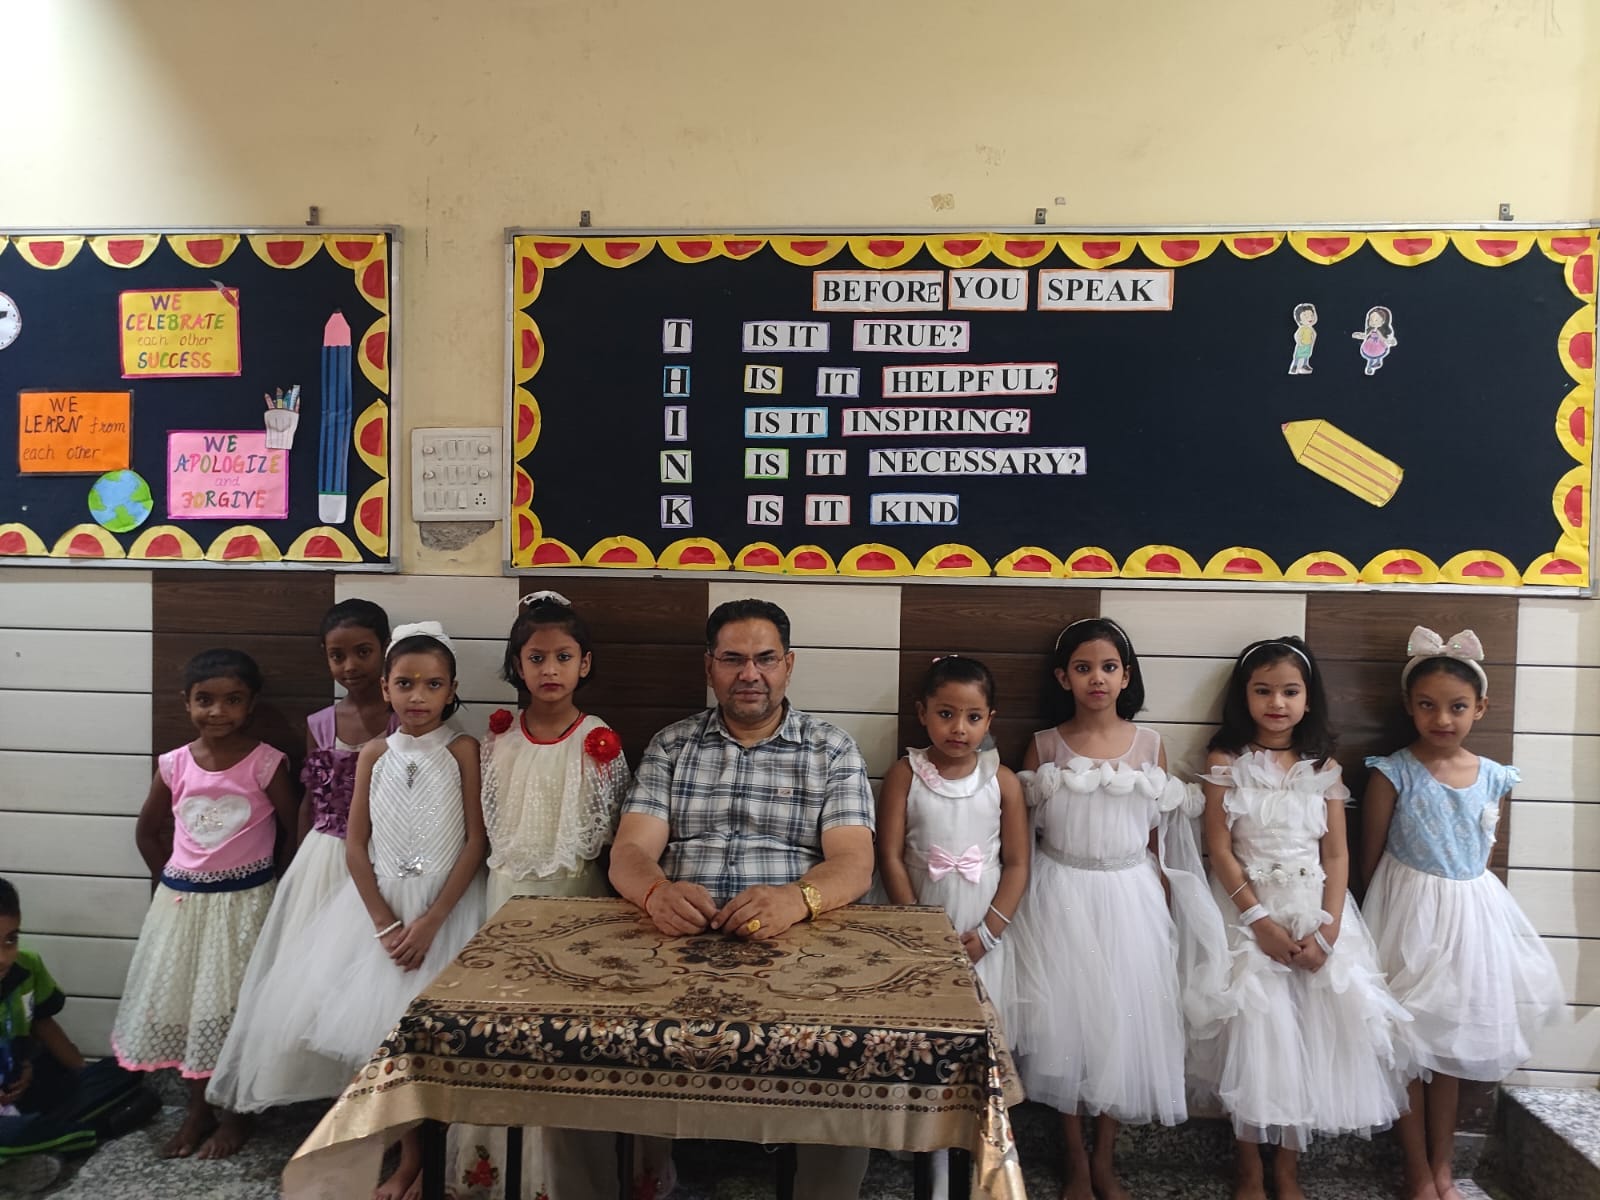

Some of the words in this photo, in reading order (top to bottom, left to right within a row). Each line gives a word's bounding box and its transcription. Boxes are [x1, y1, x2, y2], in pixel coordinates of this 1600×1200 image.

[822, 279, 942, 303] BEFORE
[953, 276, 1021, 300] YOU
[1047, 278, 1155, 302] SPEAK
[151, 294, 182, 311] WE
[125, 313, 225, 331] CELEBRATE
[138, 335, 169, 346] each
[179, 333, 212, 346] other
[667, 321, 691, 348] T
[752, 324, 778, 347] IS
[788, 325, 819, 347] IT
[863, 323, 963, 347] TRUE?
[137, 351, 212, 369] SUCCESS
[665, 367, 689, 394] H
[749, 367, 776, 390] IS
[823, 372, 855, 394] IT
[49, 396, 78, 412] WE
[24, 415, 83, 433] LEARN
[89, 416, 126, 434] from
[669, 410, 681, 436] I
[753, 411, 780, 434] IS
[789, 411, 821, 434] IT
[851, 409, 1028, 433] INSPIRING?
[23, 443, 55, 460] each
[66, 446, 101, 459] other
[203, 434, 238, 452] WE
[174, 453, 282, 474] APOLOGIZE
[664, 453, 688, 480] N
[753, 453, 780, 475] IS
[811, 453, 842, 475] IT
[877, 450, 1082, 475] NECESSARY?
[215, 476, 240, 487] and
[664, 498, 690, 525] K
[753, 500, 780, 522] IS
[813, 500, 843, 522] IT
[880, 500, 959, 523] KIND
